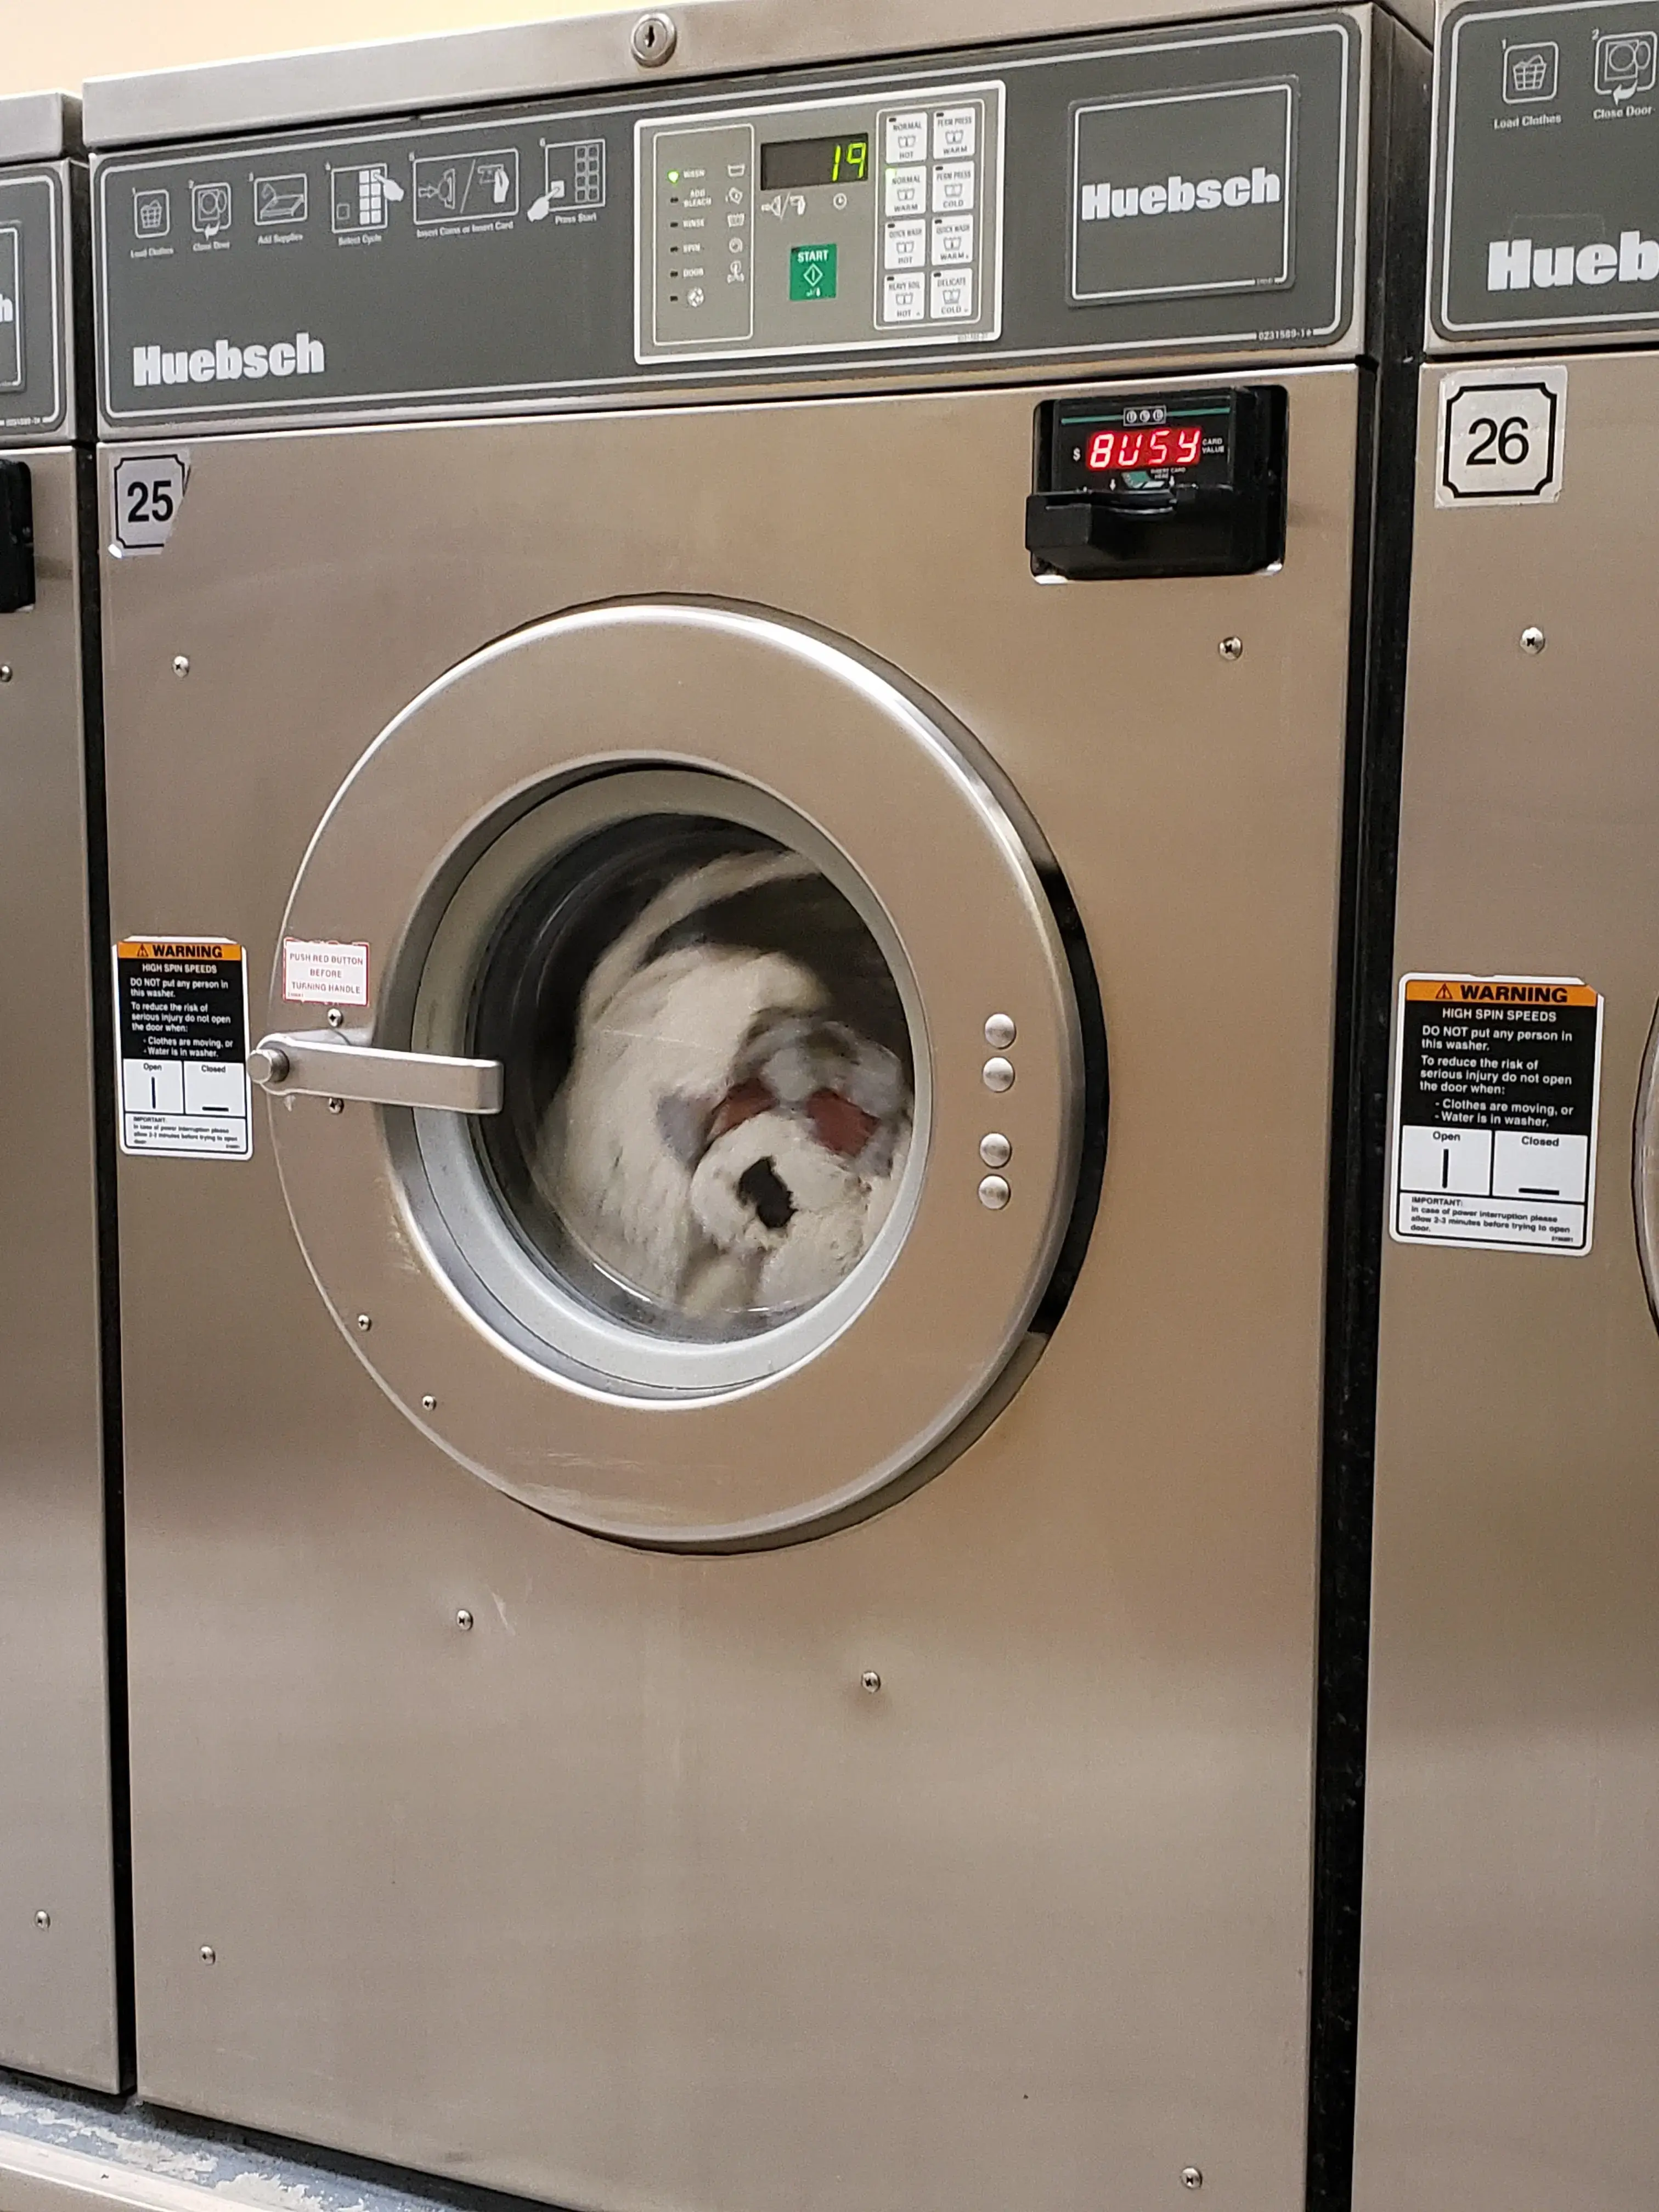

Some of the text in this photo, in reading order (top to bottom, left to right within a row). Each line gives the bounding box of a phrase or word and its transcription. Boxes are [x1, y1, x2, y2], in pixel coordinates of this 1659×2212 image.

[1592, 28, 1599, 40] 2
[1593, 105, 1652, 120] Close Door
[893, 121, 922, 131] NORMAL
[1494, 114, 1562, 130] Load Clothes
[944, 146, 967, 154] WARM
[832, 143, 866, 181] 19
[892, 176, 920, 184] NORMAL
[1082, 167, 1280, 221] Huebsch
[894, 204, 918, 212] WARM
[943, 200, 963, 208] COLD
[798, 250, 828, 262] START
[940, 252, 964, 260] WARM
[938, 277, 966, 287] DELICATE
[941, 306, 961, 315] COLD
[133, 332, 324, 386] Huebsch
[1466, 417, 1529, 465] 26
[1073, 448, 1081, 461] $
[1090, 430, 1200, 467] BUSY
[1202, 445, 1224, 454] VALUE
[127, 480, 173, 523] 25
[153, 945, 223, 958] WARNING
[313, 955, 329, 963] RED
[331, 956, 363, 965] BUTTON
[142, 963, 217, 973] HIGH SPIN SPEEDS
[310, 969, 342, 978] BEFORE
[131, 977, 228, 990] DO NOT put any person in
[292, 981, 360, 994] TURNING HANDLE
[131, 989, 176, 998] this washer.
[1460, 985, 1567, 1003] WARNING
[131, 1001, 208, 1012] To reduce the risk of
[132, 1013, 160, 1022] serious
[161, 1013, 183, 1024] injury
[197, 1014, 210, 1023] not
[211, 1016, 231, 1025] open
[1442, 1007, 1557, 1023] HIGH SPIN SPEEDS
[132, 1023, 188, 1033] the door when:
[1423, 1025, 1572, 1042] DO NOT put any person in
[148, 1036, 177, 1046] Clothes
[193, 1038, 223, 1049] moving,
[1421, 1039, 1489, 1051] this washer.
[148, 1046, 218, 1058] Water is in washer.
[143, 1063, 162, 1071] Open
[1421, 1054, 1539, 1070] To reduce the risk of
[201, 1064, 226, 1073] Closed
[1420, 1068, 1572, 1086] serious injury do not open
[1420, 1081, 1505, 1095] the door when:
[1442, 1098, 1574, 1116] Clothes are moving, or
[1441, 1111, 1475, 1123] Water
[1477, 1112, 1487, 1124] is
[1491, 1113, 1501, 1124] in
[1432, 1131, 1461, 1142] Open
[1521, 1136, 1559, 1147] Closed
[1480, 1210, 1528, 1221] interruption
[1530, 1214, 1558, 1222] please
[1410, 1224, 1431, 1232] door.
[1448, 1218, 1481, 1227] minutes
[1483, 1220, 1509, 1228] before
[1512, 1222, 1536, 1232] trying
